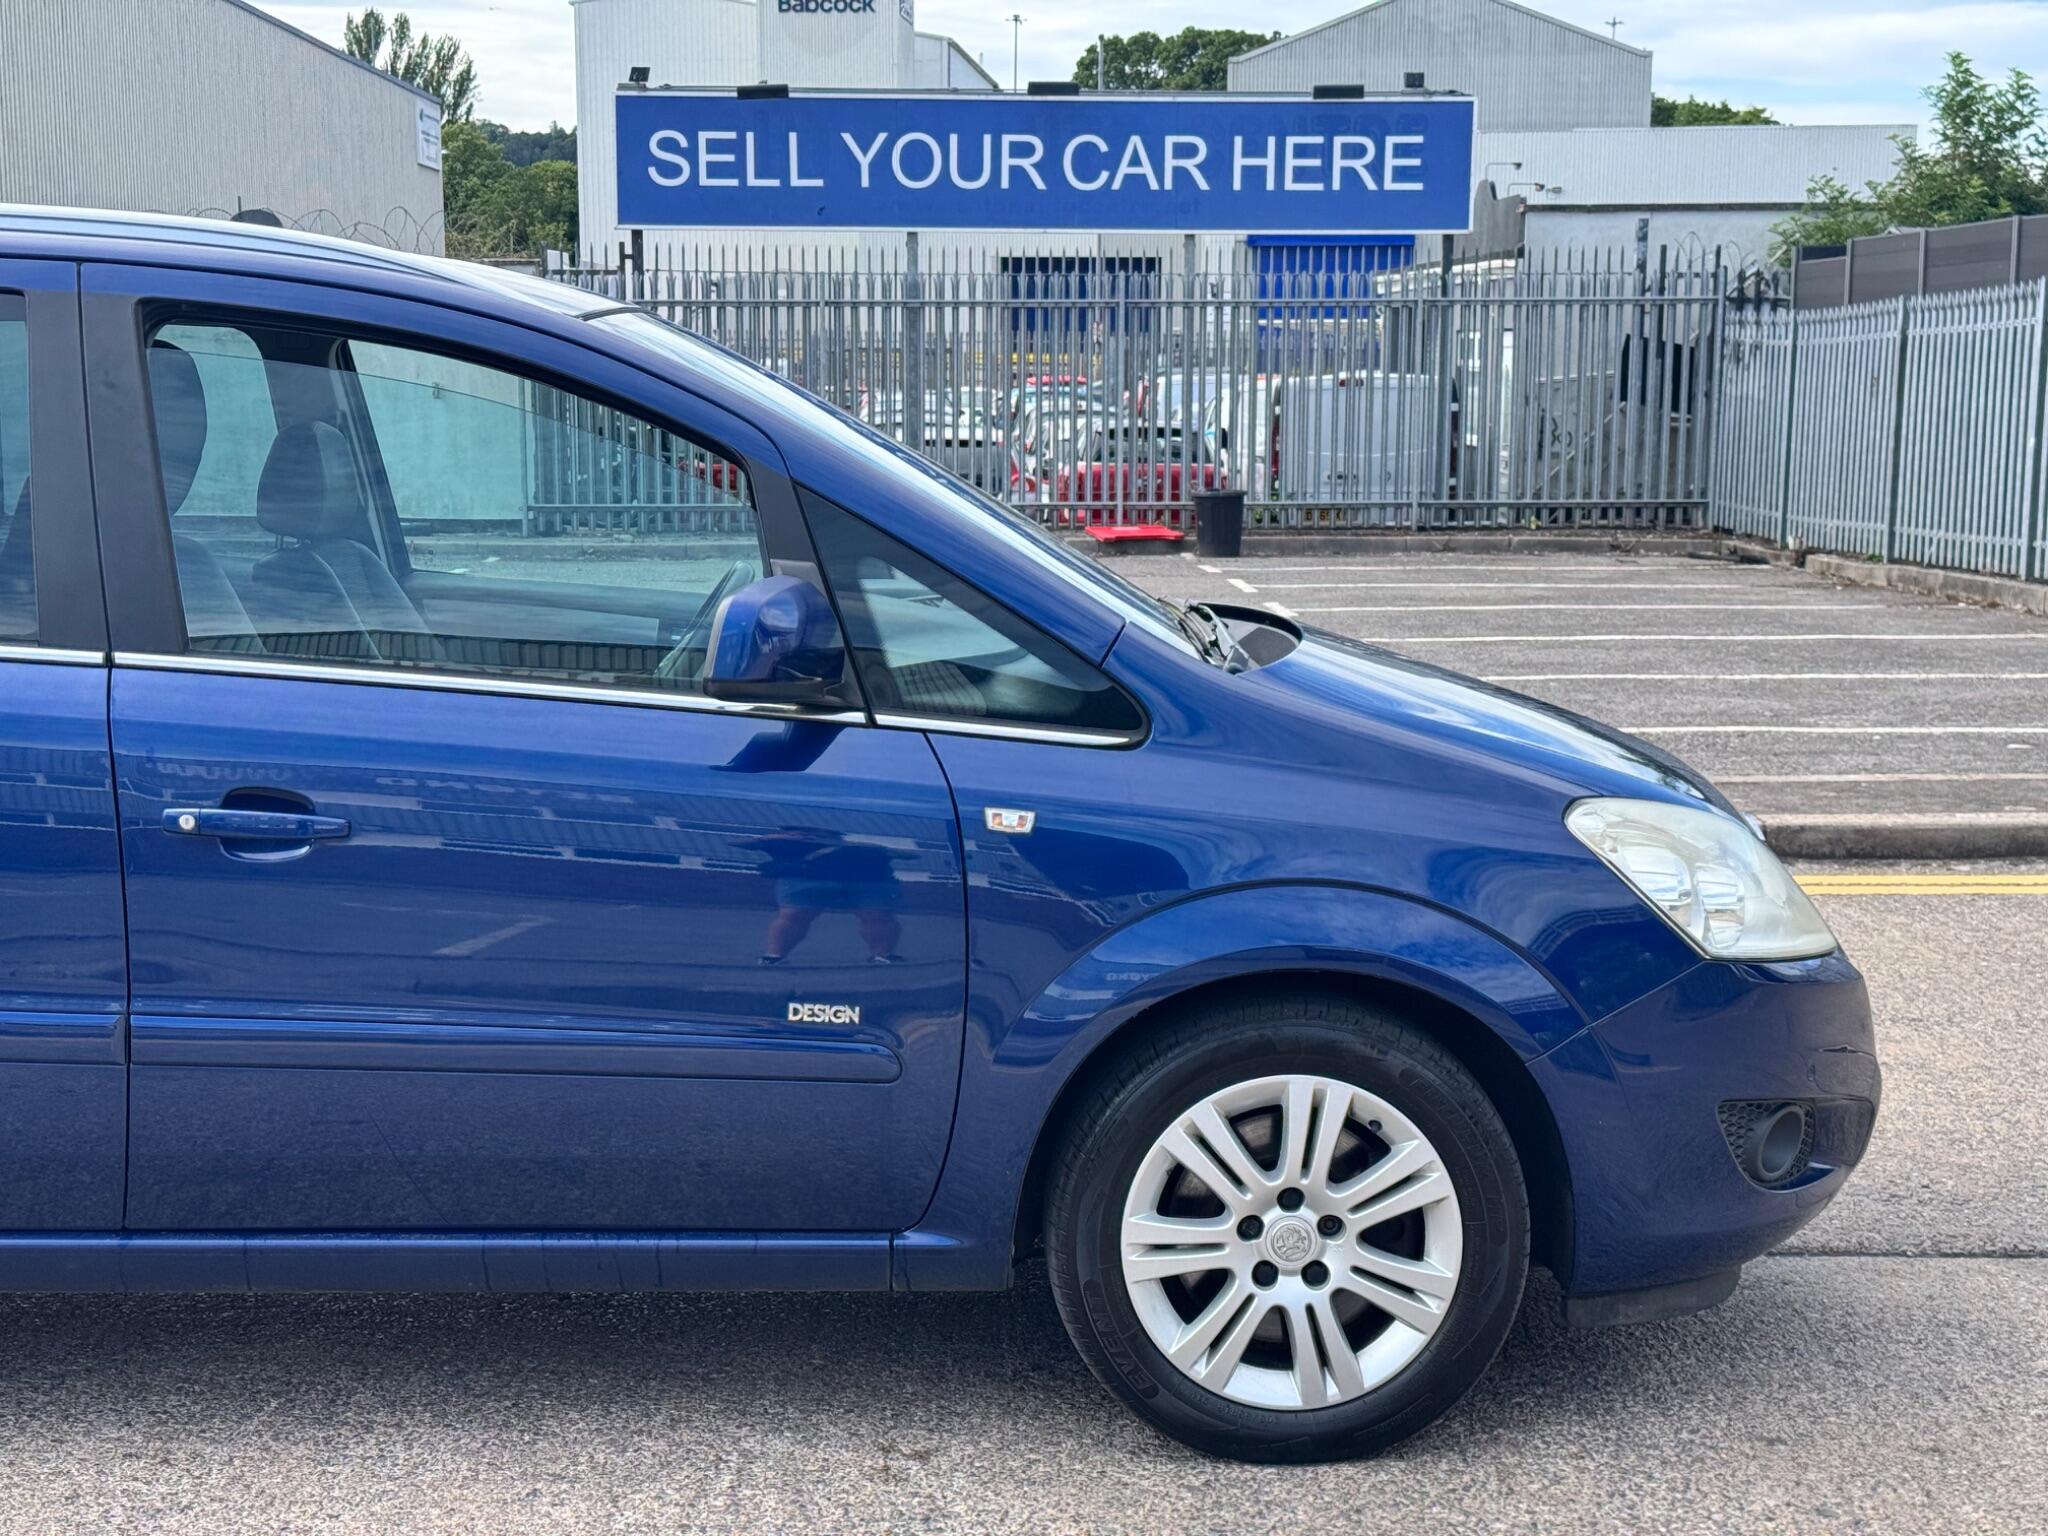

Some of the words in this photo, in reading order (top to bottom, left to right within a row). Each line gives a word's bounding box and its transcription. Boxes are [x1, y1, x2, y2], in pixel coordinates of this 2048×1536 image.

[778, 0, 876, 13] Babcock
[647, 129, 824, 188] SELL
[840, 132, 1047, 191] YOUR
[1062, 134, 1211, 192] CAR
[1232, 135, 1425, 192] HERE
[787, 1002, 861, 1025] DESIGN
